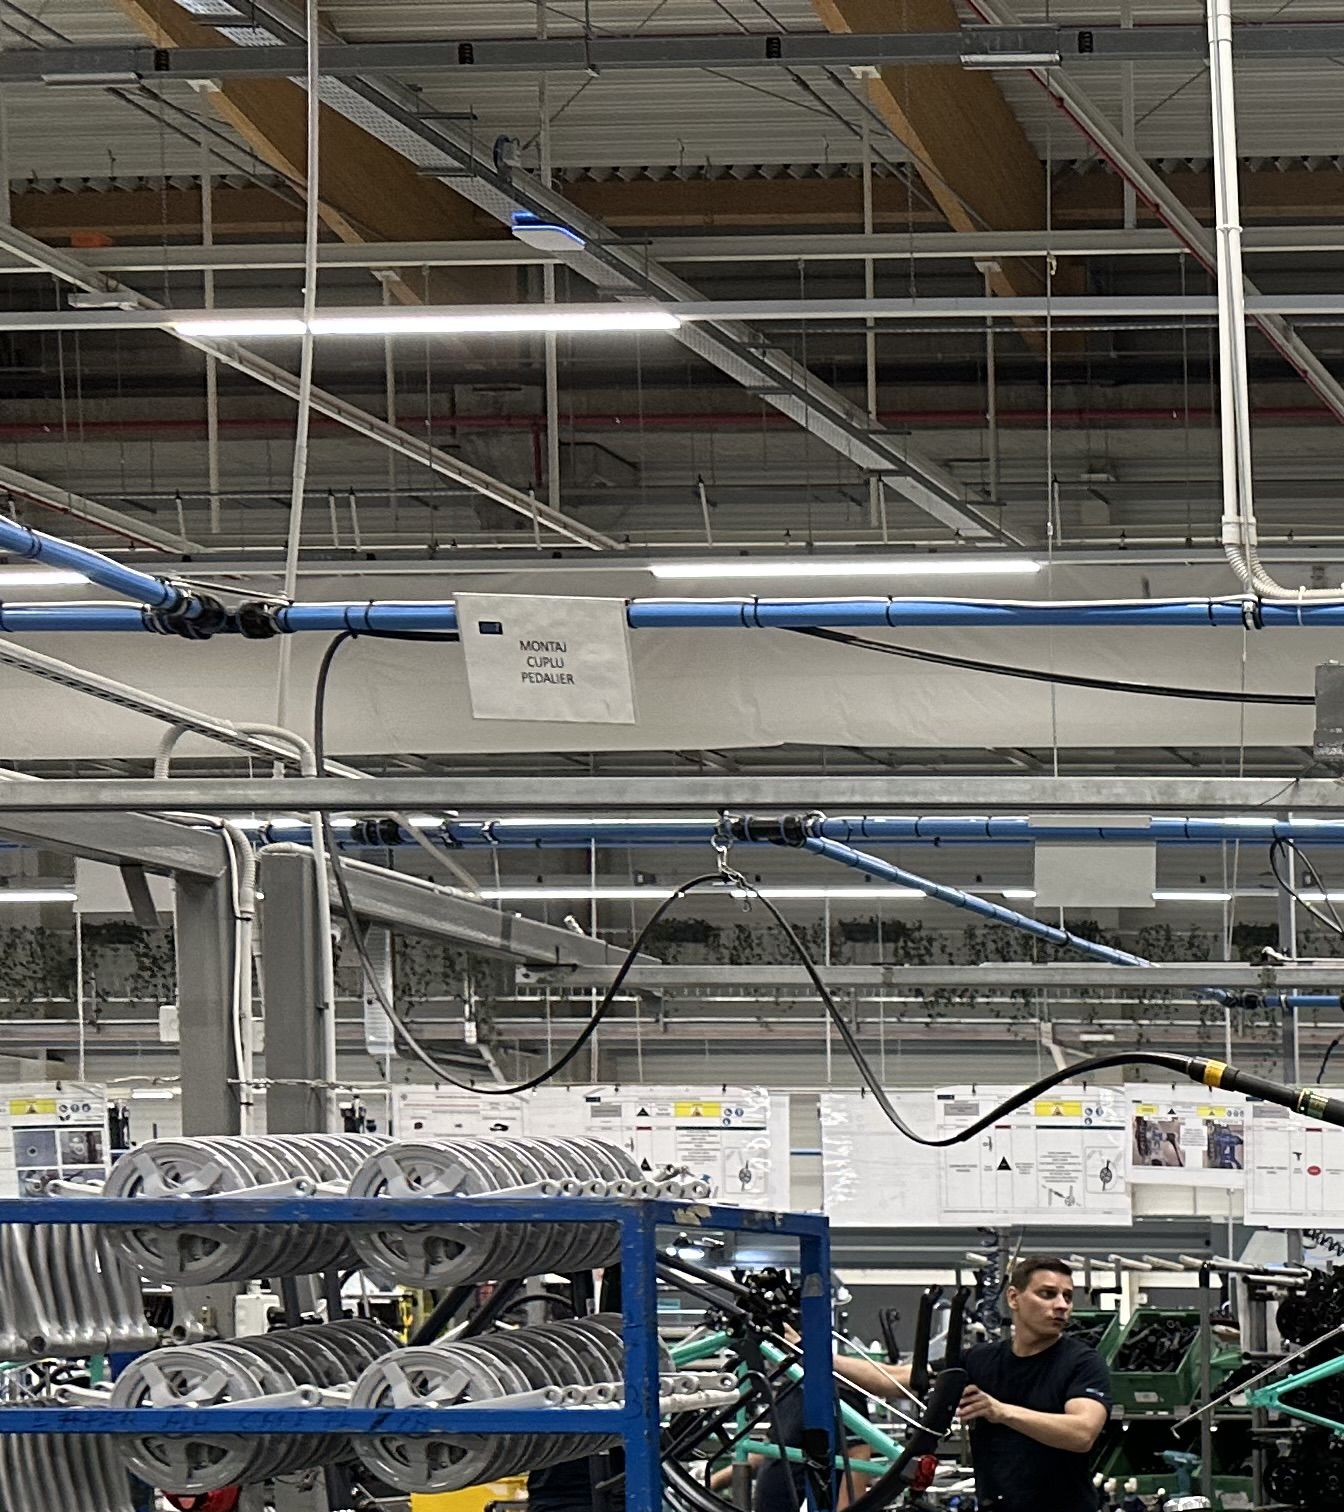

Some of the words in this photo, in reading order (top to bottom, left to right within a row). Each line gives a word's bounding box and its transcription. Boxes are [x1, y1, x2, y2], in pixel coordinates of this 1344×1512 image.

[519, 640, 567, 652] MONTAJ
[526, 655, 565, 668] CUPLU
[520, 671, 575, 685] PEDALIER
